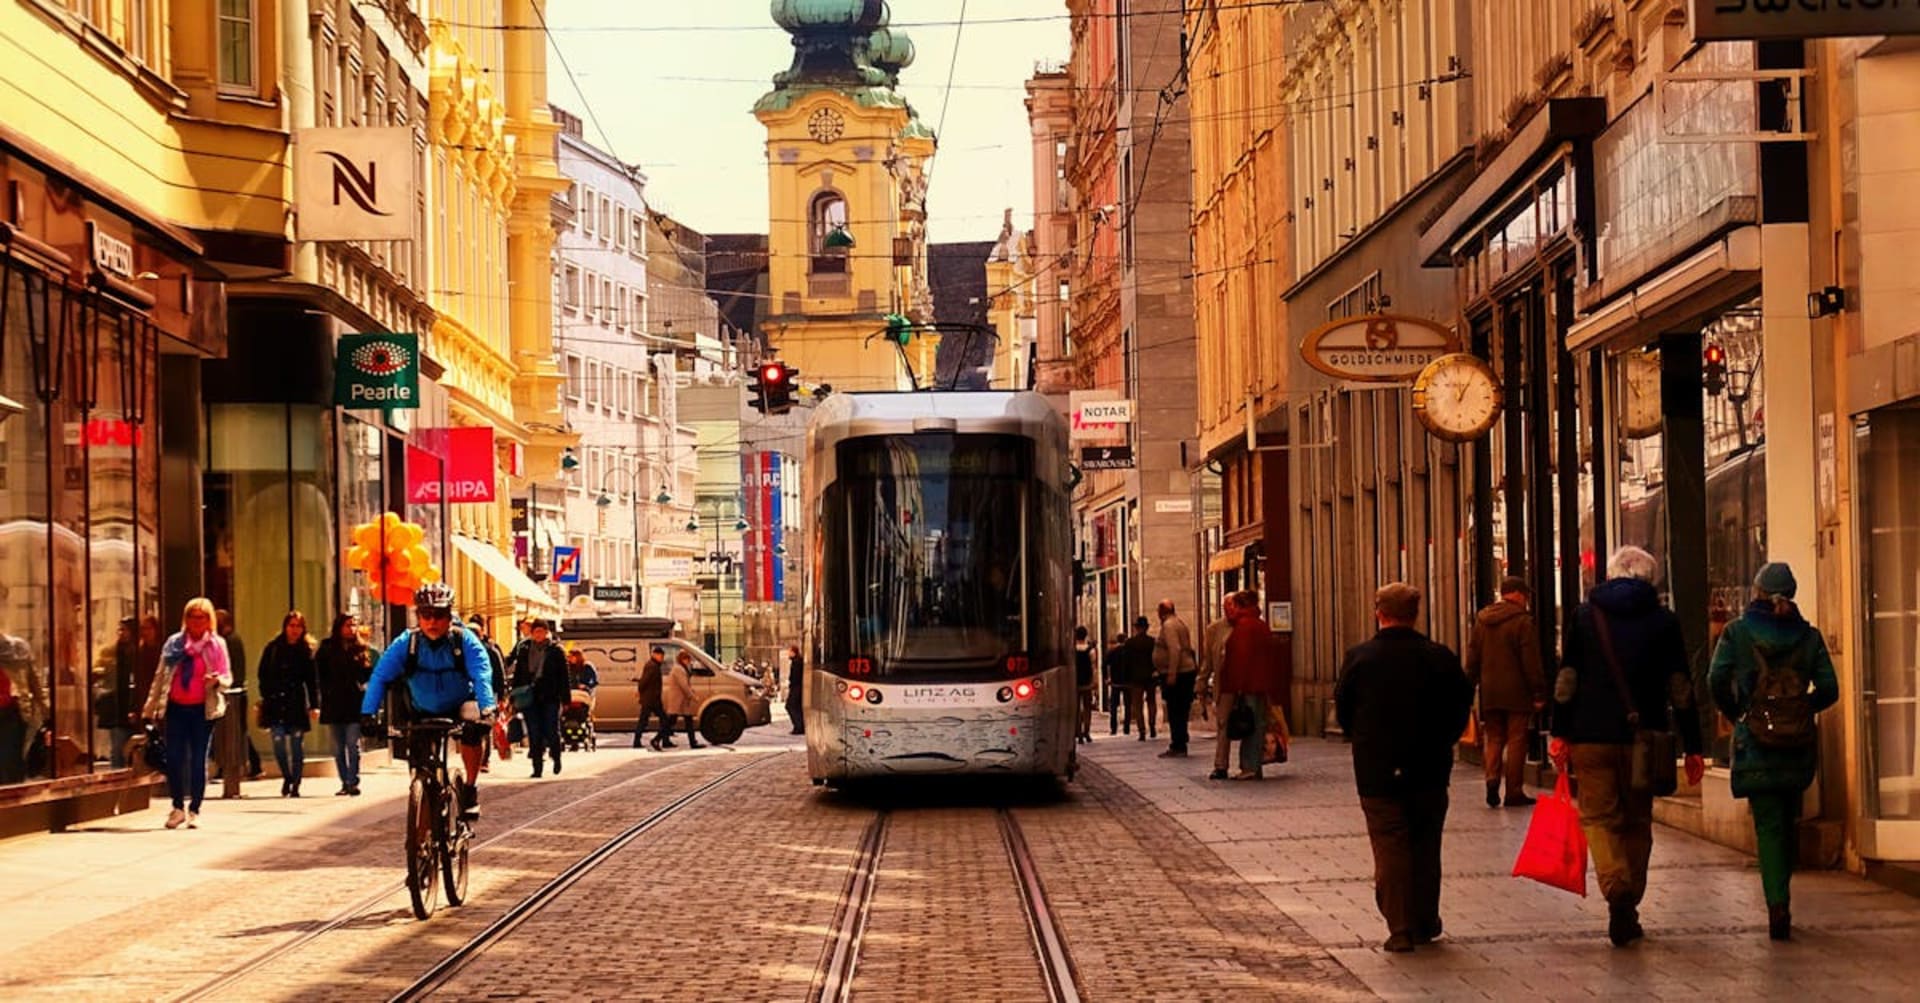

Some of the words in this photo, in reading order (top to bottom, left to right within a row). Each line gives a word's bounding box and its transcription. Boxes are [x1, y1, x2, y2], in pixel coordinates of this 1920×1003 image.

[1330, 354, 1432, 366] GOLDSCHMIEDE
[351, 383, 411, 400] Pearle
[1084, 407, 1127, 417] NOTAR
[950, 688, 975, 697] AG
